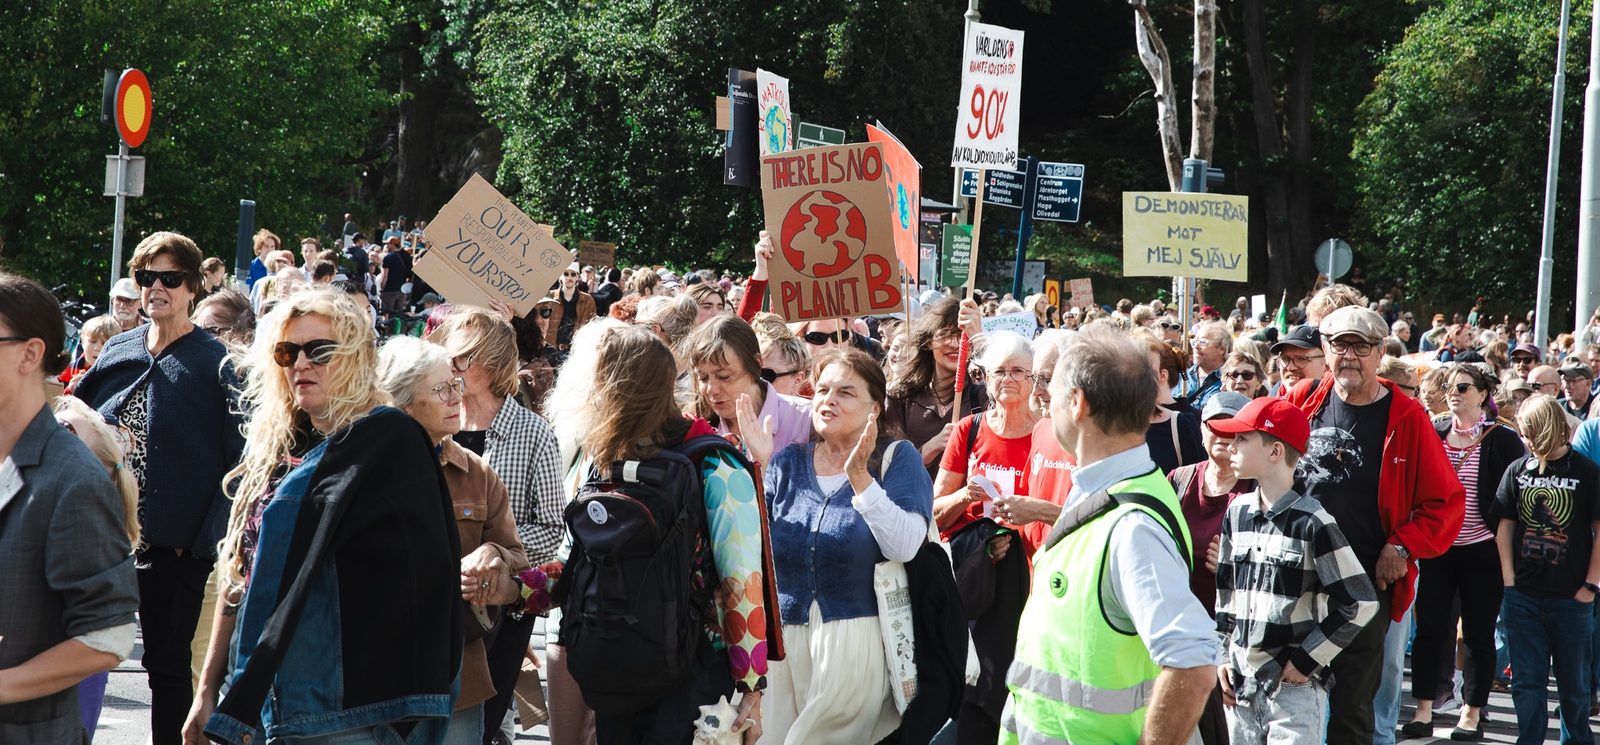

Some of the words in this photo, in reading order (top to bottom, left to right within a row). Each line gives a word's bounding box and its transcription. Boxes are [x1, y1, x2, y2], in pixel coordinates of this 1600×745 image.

[976, 32, 1009, 59] VÄRLDENS
[967, 84, 1009, 141] 90%
[953, 146, 963, 163] AV
[763, 153, 820, 189] THERE
[821, 151, 845, 184] IS
[847, 146, 882, 182] NO
[991, 170, 1015, 180] Guldheden
[989, 186, 1012, 196] Botaniska
[996, 179, 1023, 190] Sahlgrenska
[1039, 186, 1068, 196] Järntorget
[1040, 178, 1063, 187] Centrum
[1037, 202, 1052, 210] Haga
[1038, 194, 1071, 204] Masthugget
[1036, 209, 1060, 218] Olivedal
[1135, 195, 1247, 223] DEMONSTERAR
[494, 196, 508, 213] THIS
[509, 211, 533, 234] PLANET
[532, 231, 544, 241] IS
[480, 206, 530, 258] OUR
[1167, 225, 1203, 241] MOT
[458, 212, 533, 276] RESPONSIBILITY!
[1147, 246, 1183, 264] MEJ
[1189, 247, 1241, 270] SJÄLV
[781, 277, 860, 322] PLANET
[863, 254, 902, 310] B
[1009, 316, 1033, 329] CHANGE
